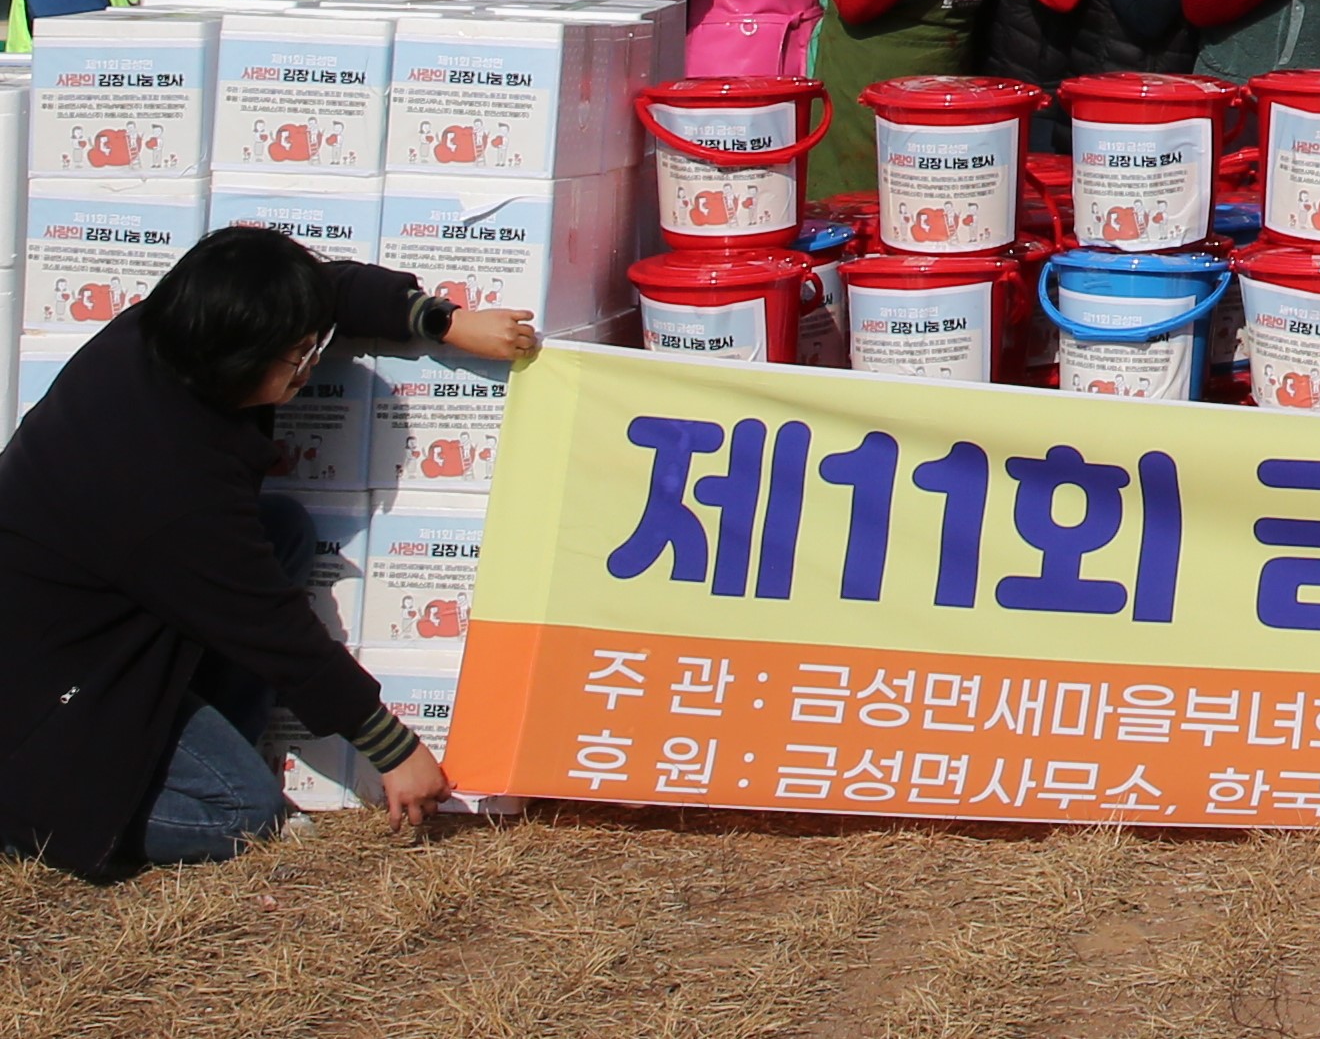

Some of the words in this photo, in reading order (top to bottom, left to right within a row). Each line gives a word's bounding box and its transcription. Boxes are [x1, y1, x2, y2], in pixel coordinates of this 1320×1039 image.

[56, 73, 96, 87] 사랑의
[98, 73, 125, 87] 김장
[127, 73, 154, 87] 나눔
[156, 73, 184, 87] 행사
[241, 67, 280, 81] 사랑의
[283, 68, 309, 83] 김장
[312, 70, 337, 84] 나눔
[340, 71, 366, 85] 행사
[408, 68, 446, 83] 사랑의
[449, 70, 475, 84] 김장
[478, 71, 503, 85] 나눔
[506, 72, 532, 87] 행사
[887, 154, 914, 167] 사랑의
[918, 156, 942, 170] 김장
[945, 157, 969, 170] 나눔
[972, 154, 995, 168] 행사
[1109, 154, 1131, 168] 김장
[1134, 155, 1157, 168] 나눔
[1160, 151, 1183, 166] 행사
[44, 225, 83, 240] 사랑의
[86, 227, 112, 242] 김장
[115, 229, 141, 244] 나눔
[144, 230, 171, 246] 행사
[297, 223, 322, 238] 나눔
[326, 225, 353, 240] 행사
[401, 224, 439, 239] 사랑의
[442, 226, 468, 240] 김장
[470, 226, 496, 241] 나눔
[500, 227, 526, 242] 행사
[861, 319, 887, 333] 사랑의
[890, 320, 913, 334] 김장
[915, 320, 940, 334] 나눔
[943, 318, 967, 331] 행사
[1256, 314, 1287, 329] 사랑의
[1289, 320, 1313, 335] 김장
[661, 334, 681, 348] 김장
[683, 337, 705, 350] 나눔
[708, 335, 734, 350] 행사
[391, 383, 430, 397] 사랑의
[434, 384, 460, 398] 김장
[463, 384, 489, 398] 나눔
[606, 415, 1183, 625] 제11회
[388, 542, 428, 556] 사랑의
[432, 543, 458, 558] 김장
[774, 742, 1178, 817] 금성면사무소,
